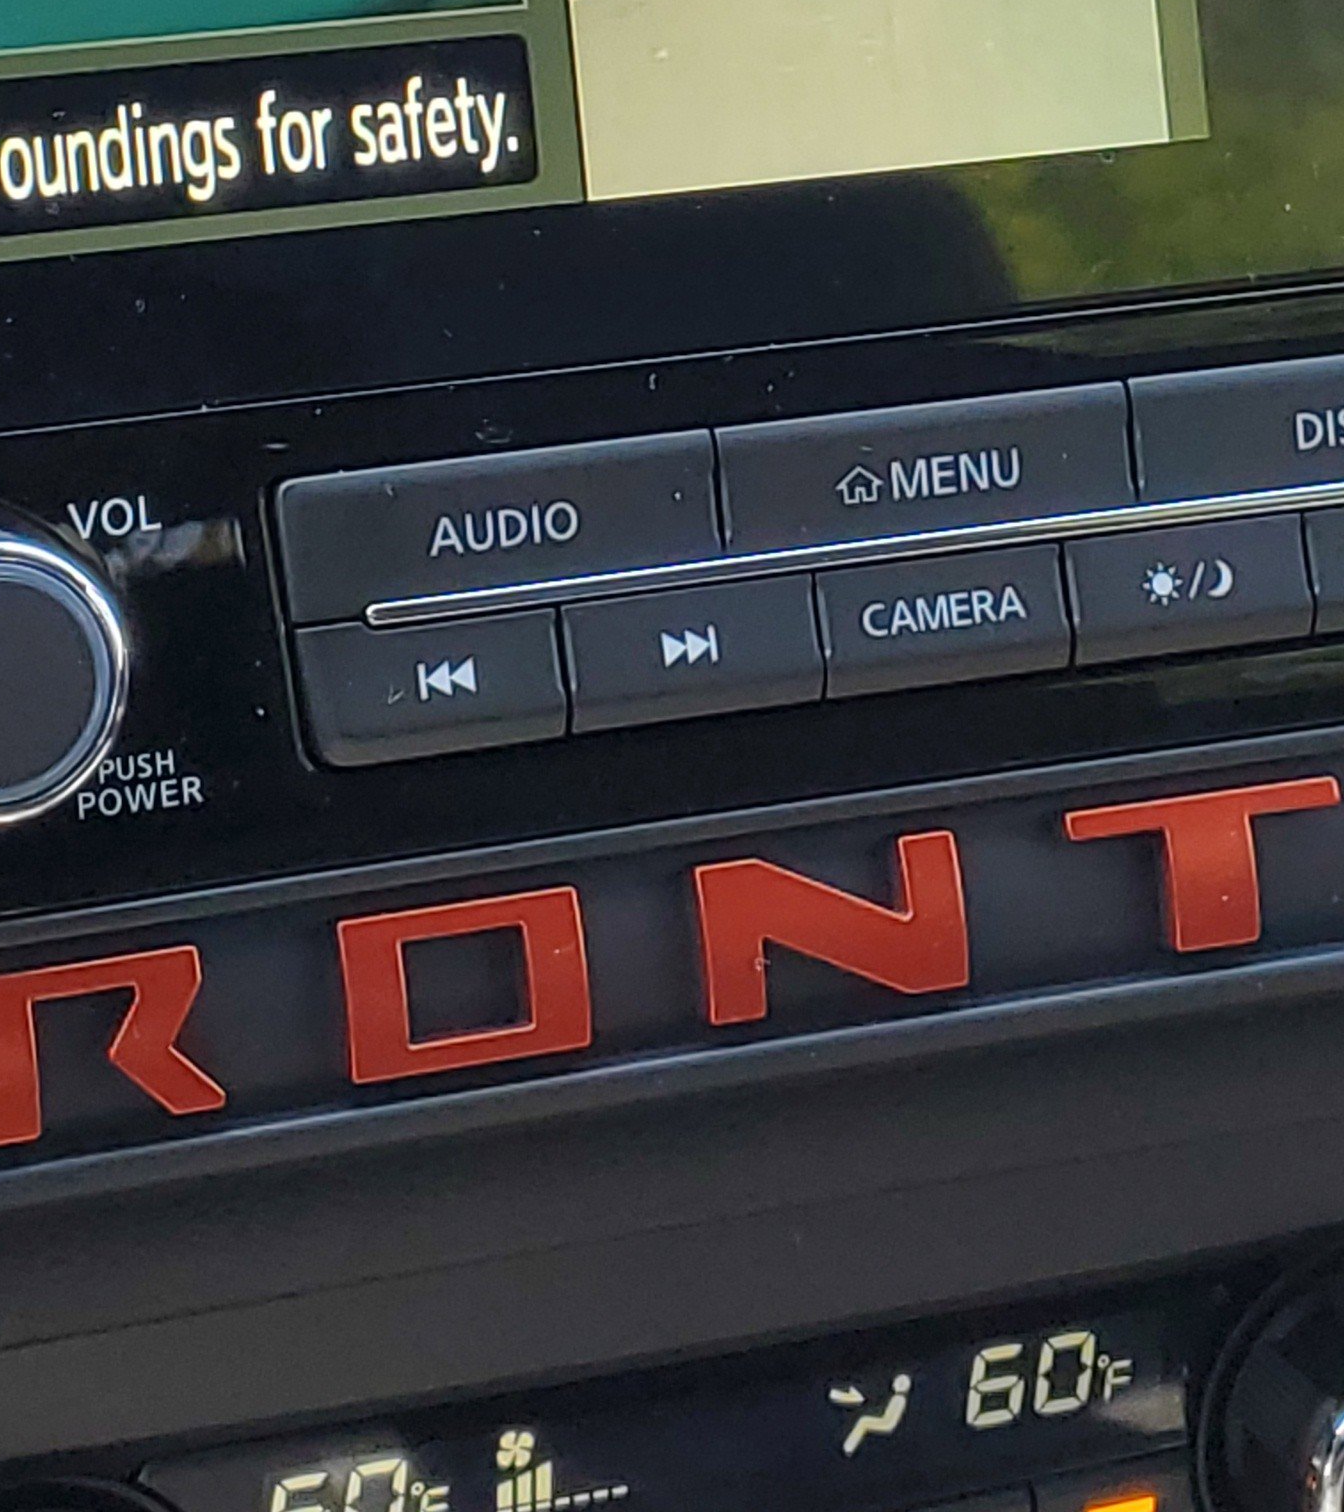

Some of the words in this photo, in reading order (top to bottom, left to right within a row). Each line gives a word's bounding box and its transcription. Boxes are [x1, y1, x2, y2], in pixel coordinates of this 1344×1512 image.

[257, 89, 332, 177] for
[351, 76, 520, 173] safety.
[889, 447, 1024, 501] MENU
[67, 495, 163, 540] VOL
[428, 501, 581, 557] AUDIO
[861, 583, 1027, 640] CAMERA
[98, 748, 176, 785] PUSH
[77, 775, 205, 821] POWER
